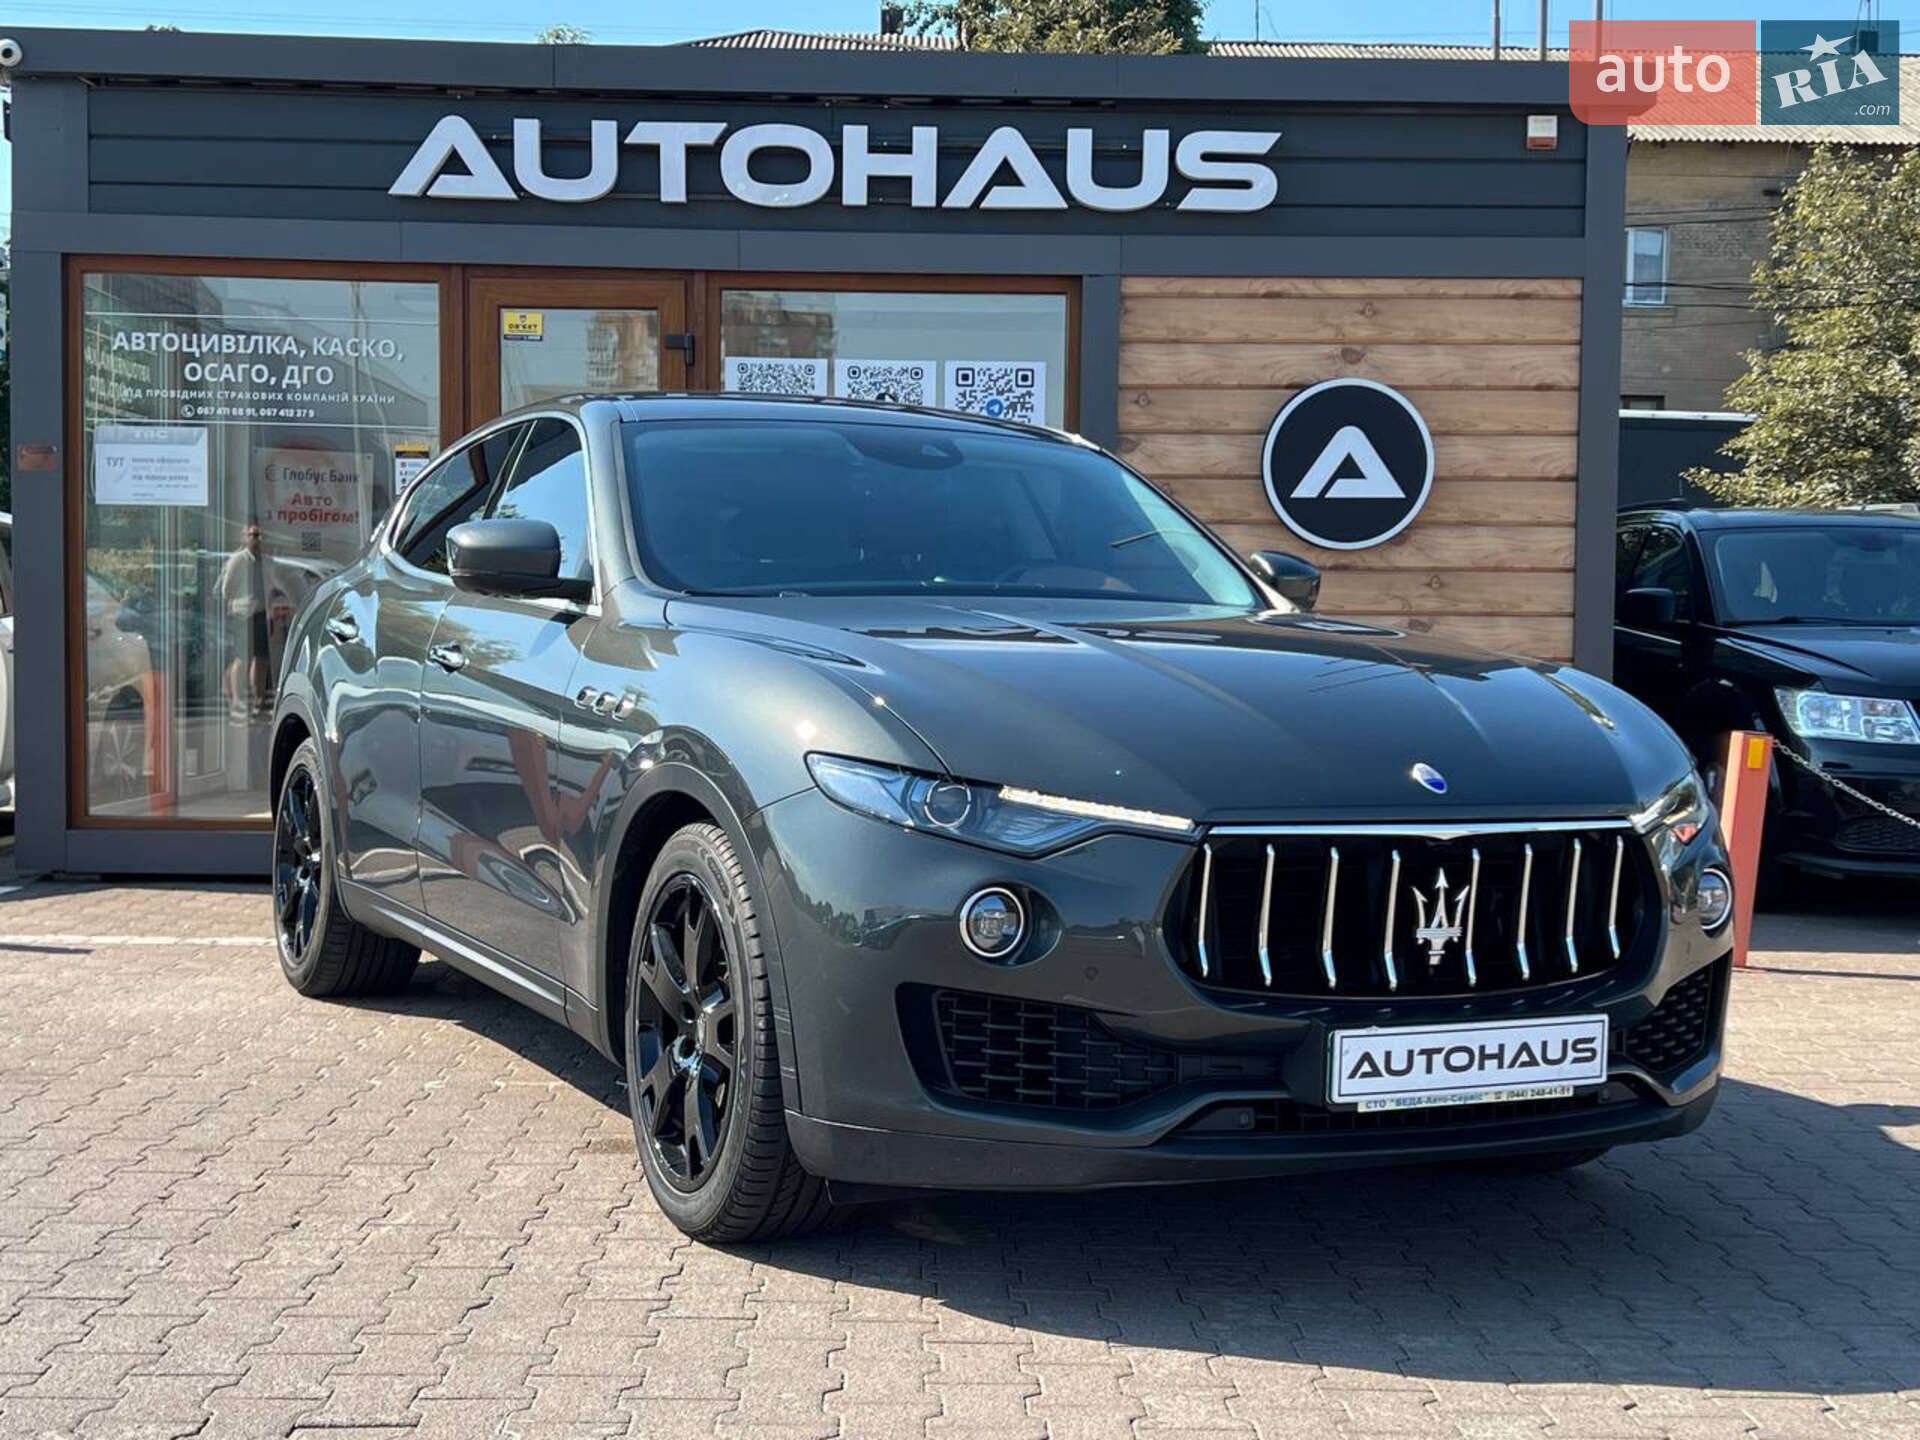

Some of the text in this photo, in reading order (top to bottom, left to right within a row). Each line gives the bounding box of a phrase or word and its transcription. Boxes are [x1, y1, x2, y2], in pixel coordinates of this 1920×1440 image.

[388, 114, 1283, 213] AUTOHAUS
[113, 332, 405, 361] АВТОЦИВІЛКА, КАСКО,
[184, 361, 334, 388] ОСАГО, ДГО
[146, 388, 214, 400] ПРОВІДНИХ
[216, 390, 284, 402] СТРАХОВИХ
[286, 391, 349, 403] КОМПАНІЙ
[283, 466, 328, 485] Глобус
[290, 492, 333, 507] Авто
[1347, 1037, 1598, 1080] AUTOHAUS
